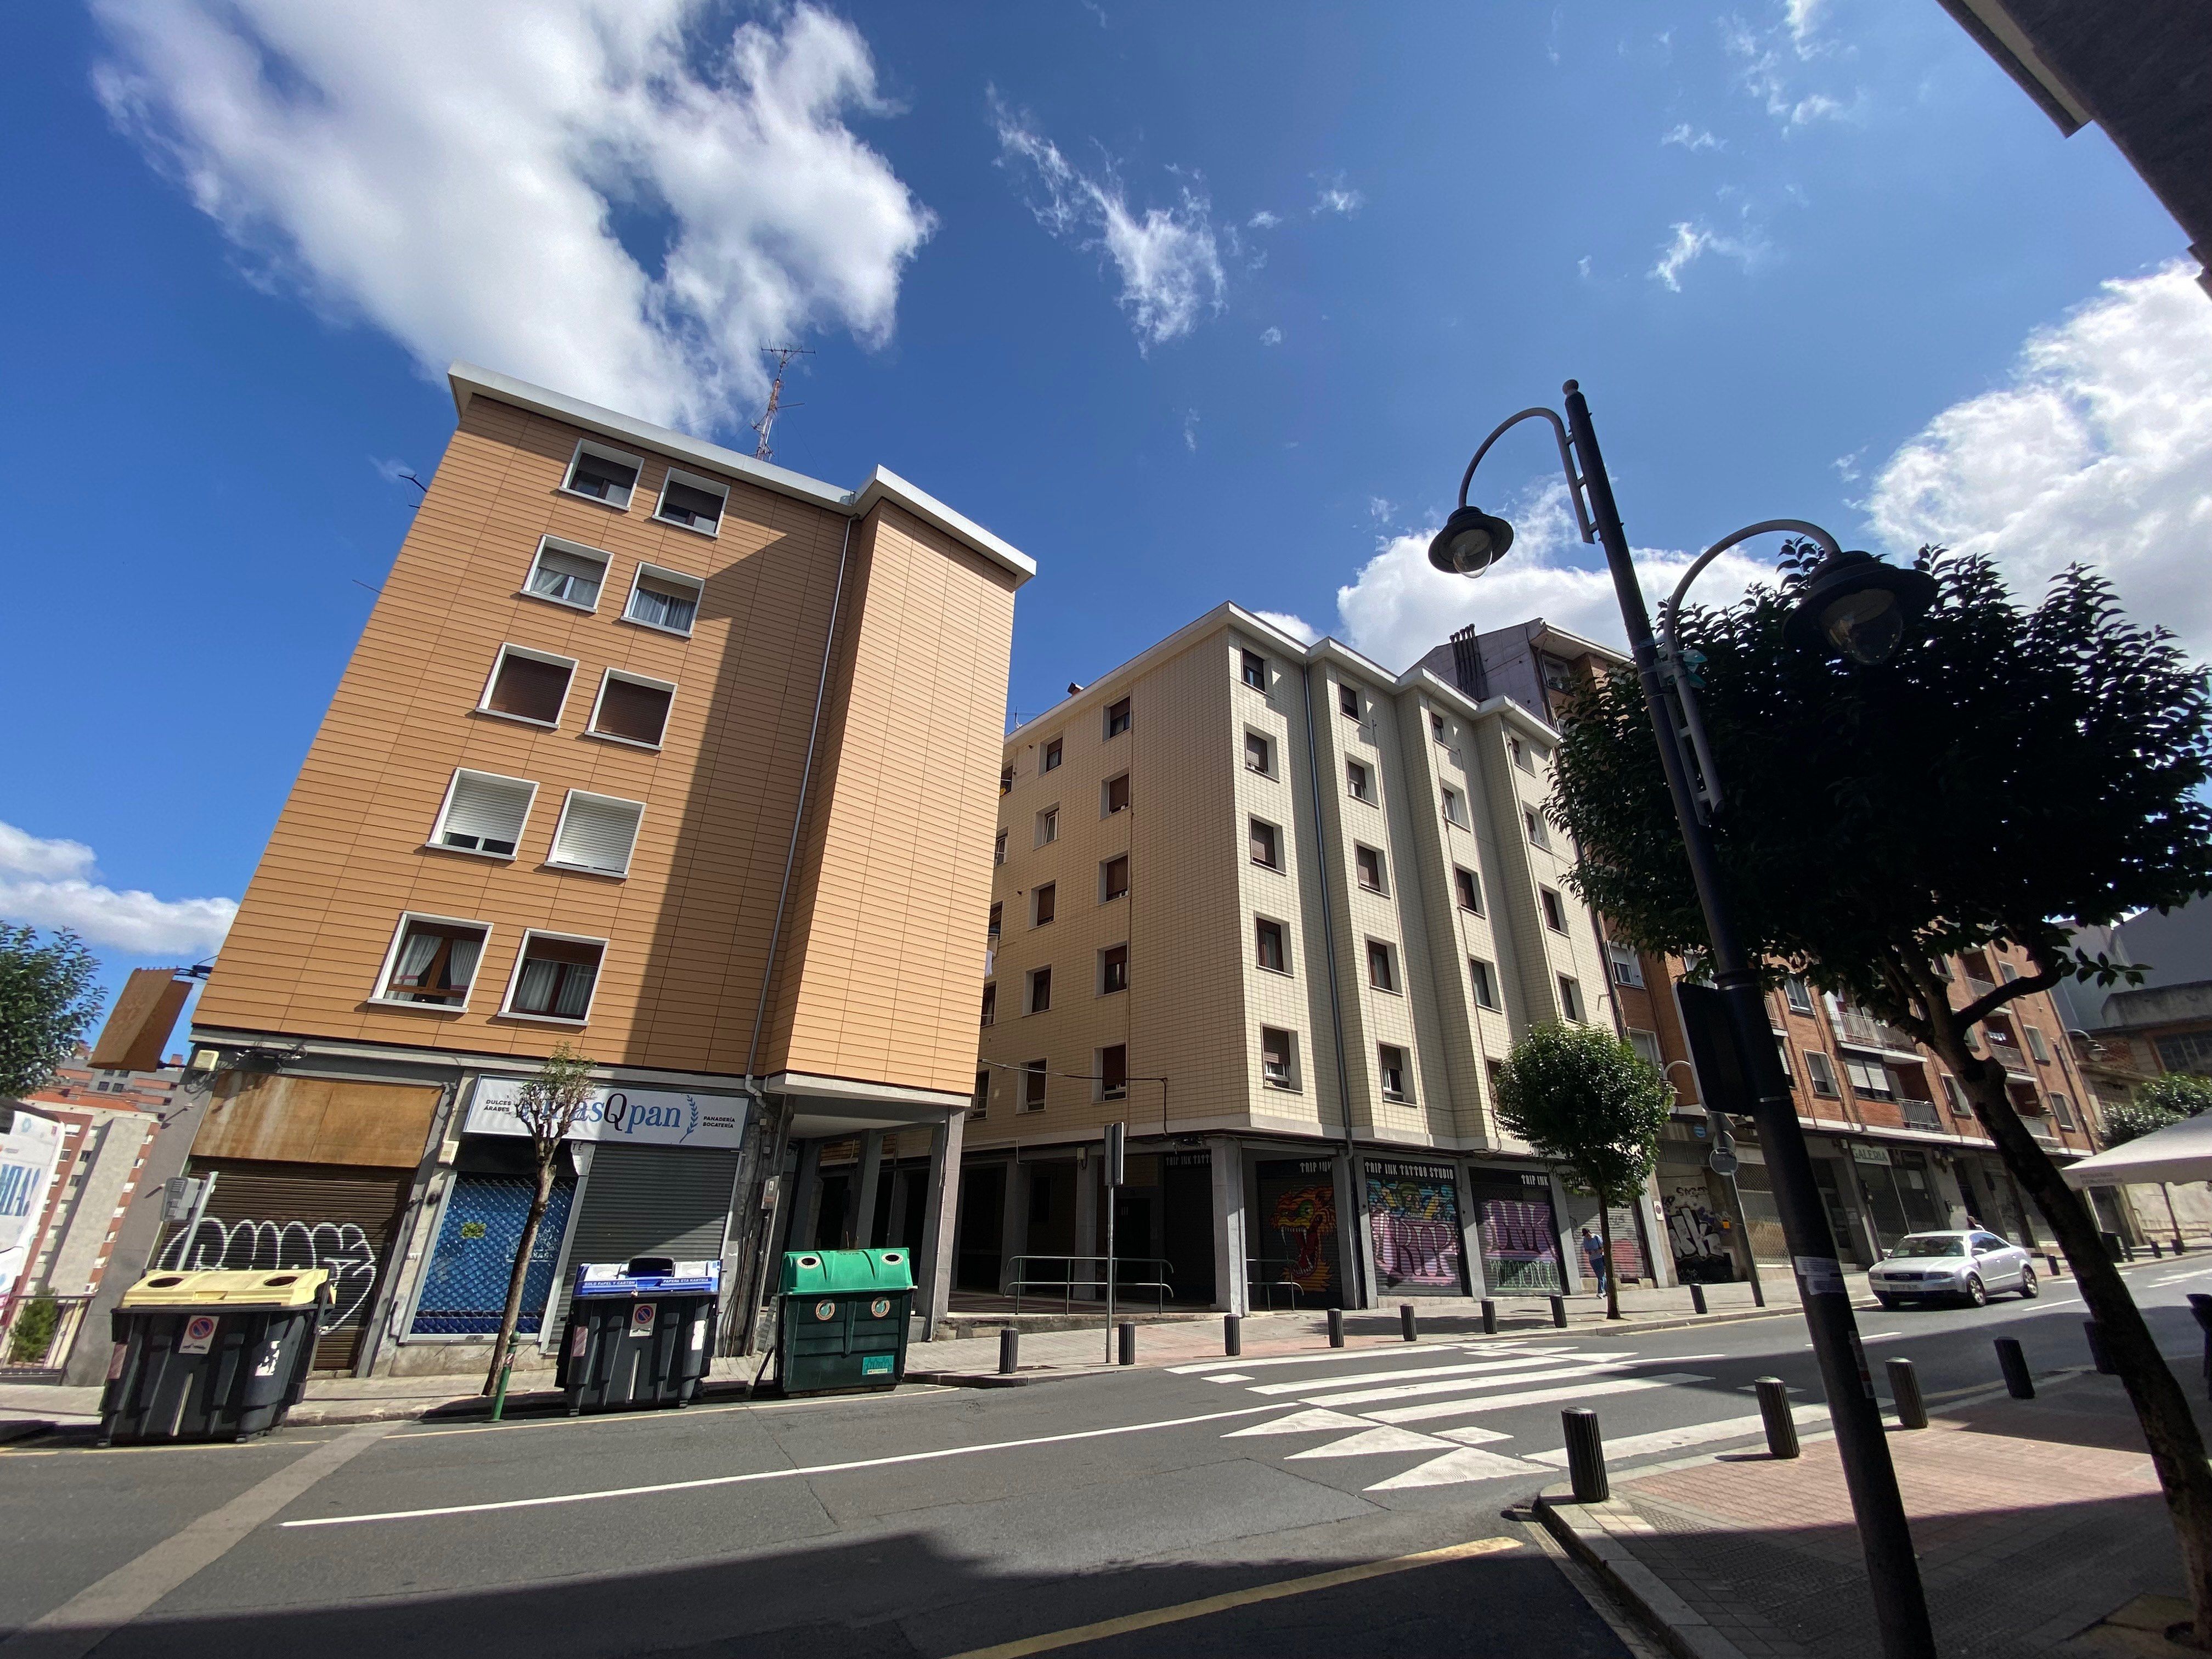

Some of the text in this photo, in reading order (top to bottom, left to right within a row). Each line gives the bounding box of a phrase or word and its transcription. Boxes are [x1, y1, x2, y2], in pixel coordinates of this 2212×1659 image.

[1181, 1155, 1192, 1165] INK
[1300, 1161, 1317, 1173] TRIP
[1365, 1161, 1454, 1180] TRIP INK TATTOO STUDIO
[1521, 1174, 1549, 1186] TRIP INK
